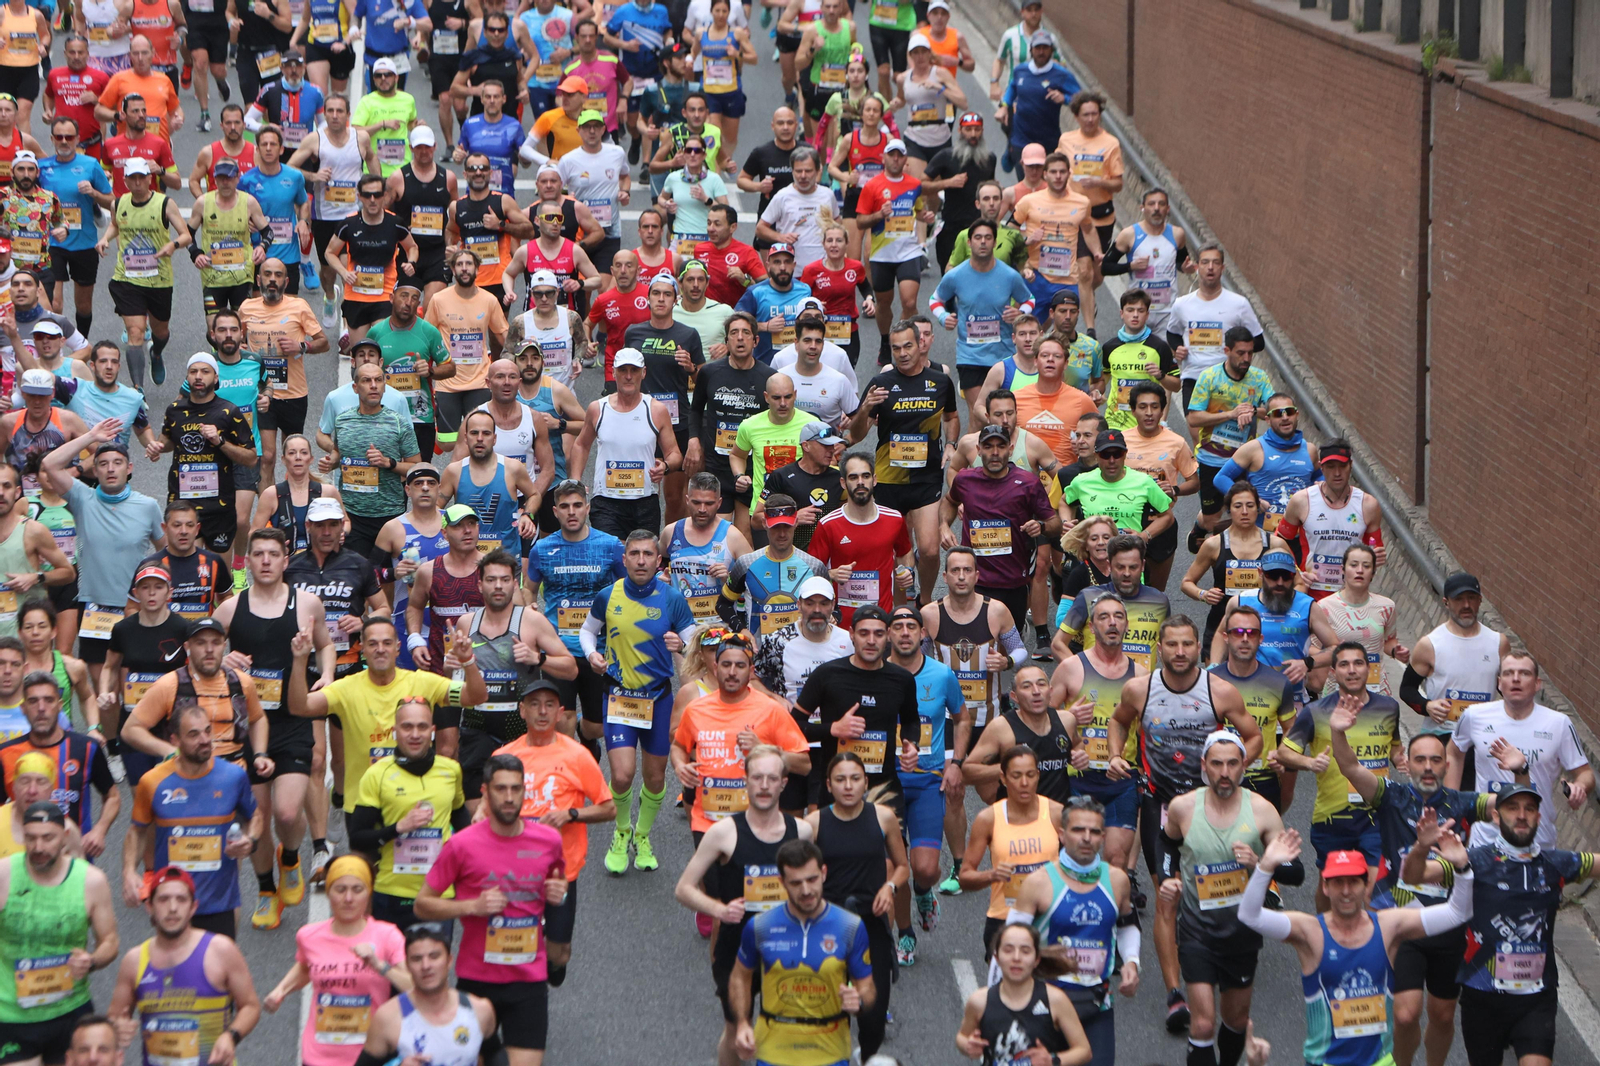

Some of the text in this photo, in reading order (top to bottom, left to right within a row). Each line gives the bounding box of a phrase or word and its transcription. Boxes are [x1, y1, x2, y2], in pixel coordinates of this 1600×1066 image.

[642, 338, 676, 350] FILA
[220, 377, 253, 388] UDEJARS
[722, 400, 760, 409] PAMPLONA
[892, 400, 937, 410] ARUNCI
[554, 566, 601, 574] FUENTERREBOLLO
[694, 587, 718, 596] ZURICH
[695, 600, 710, 608] 4864
[774, 616, 790, 624] 5496
[1122, 644, 1147, 652] ZURICH
[486, 684, 502, 693] 3497
[698, 730, 726, 741] RUN
[700, 748, 729, 758] RUN!
[716, 780, 743, 788] ZURICH
[186, 828, 216, 836] ZURICH
[411, 830, 438, 838] ZURICH
[1010, 837, 1042, 857] ADRI
[763, 866, 778, 874] ZUR
[1212, 863, 1240, 873] ZURICH
[506, 918, 534, 928] ZURICH
[1516, 945, 1542, 954] ZURICH
[1348, 986, 1380, 997] ZURICH
